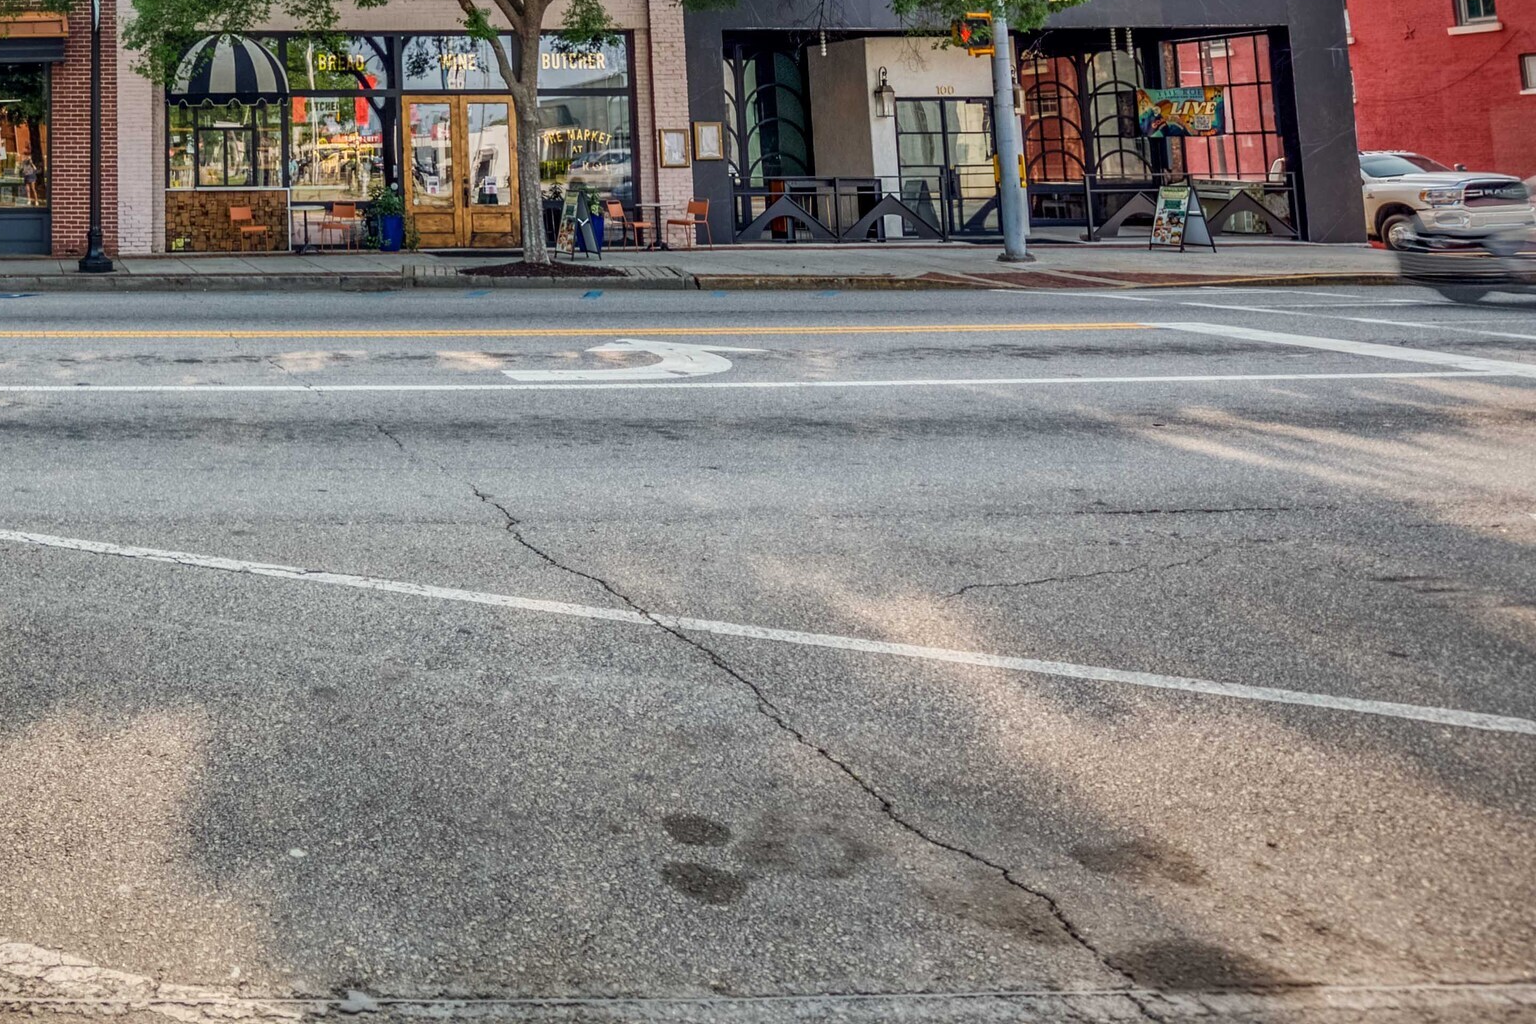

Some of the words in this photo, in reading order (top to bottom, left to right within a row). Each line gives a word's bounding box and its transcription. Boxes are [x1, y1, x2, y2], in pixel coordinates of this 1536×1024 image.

[318, 53, 365, 71] BREAD
[438, 53, 476, 71] WINE
[542, 53, 606, 70] BUTCHER
[936, 86, 954, 95] 100
[1170, 101, 1217, 115] LIVE
[542, 130, 564, 146] THE
[566, 128, 612, 146] MARKET
[572, 145, 583, 154] AT
